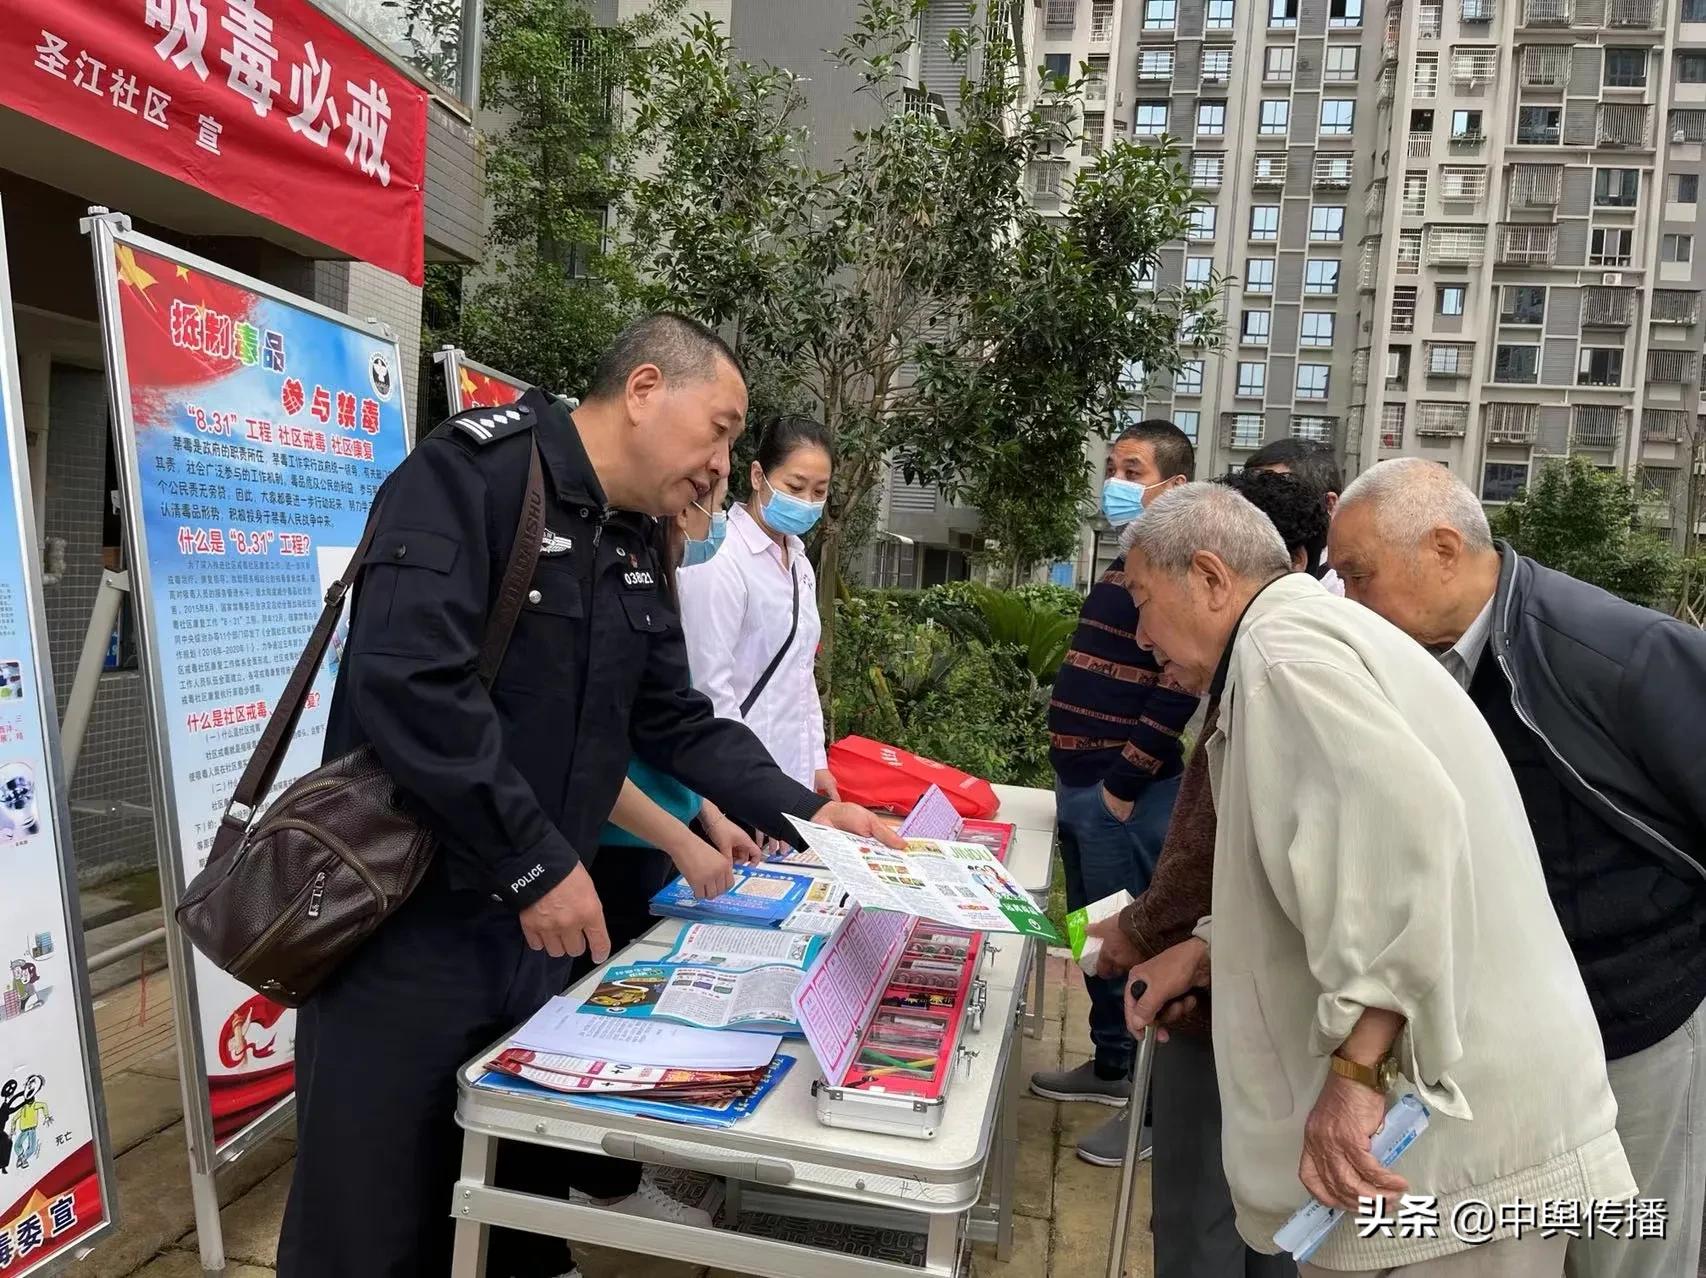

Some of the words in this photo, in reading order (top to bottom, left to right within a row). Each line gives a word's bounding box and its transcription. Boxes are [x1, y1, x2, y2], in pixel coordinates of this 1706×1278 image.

[34, 29, 173, 130] 圣江社区
[196, 115, 224, 156] 宣
[144, 0, 391, 187] 吸毒必戒
[171, 299, 285, 373] 抵制毒品
[281, 376, 380, 434] 参与禁毒
[278, 425, 326, 453] 社区戒毒
[331, 434, 374, 462] 社区康复
[511, 863, 545, 893] POLICE
